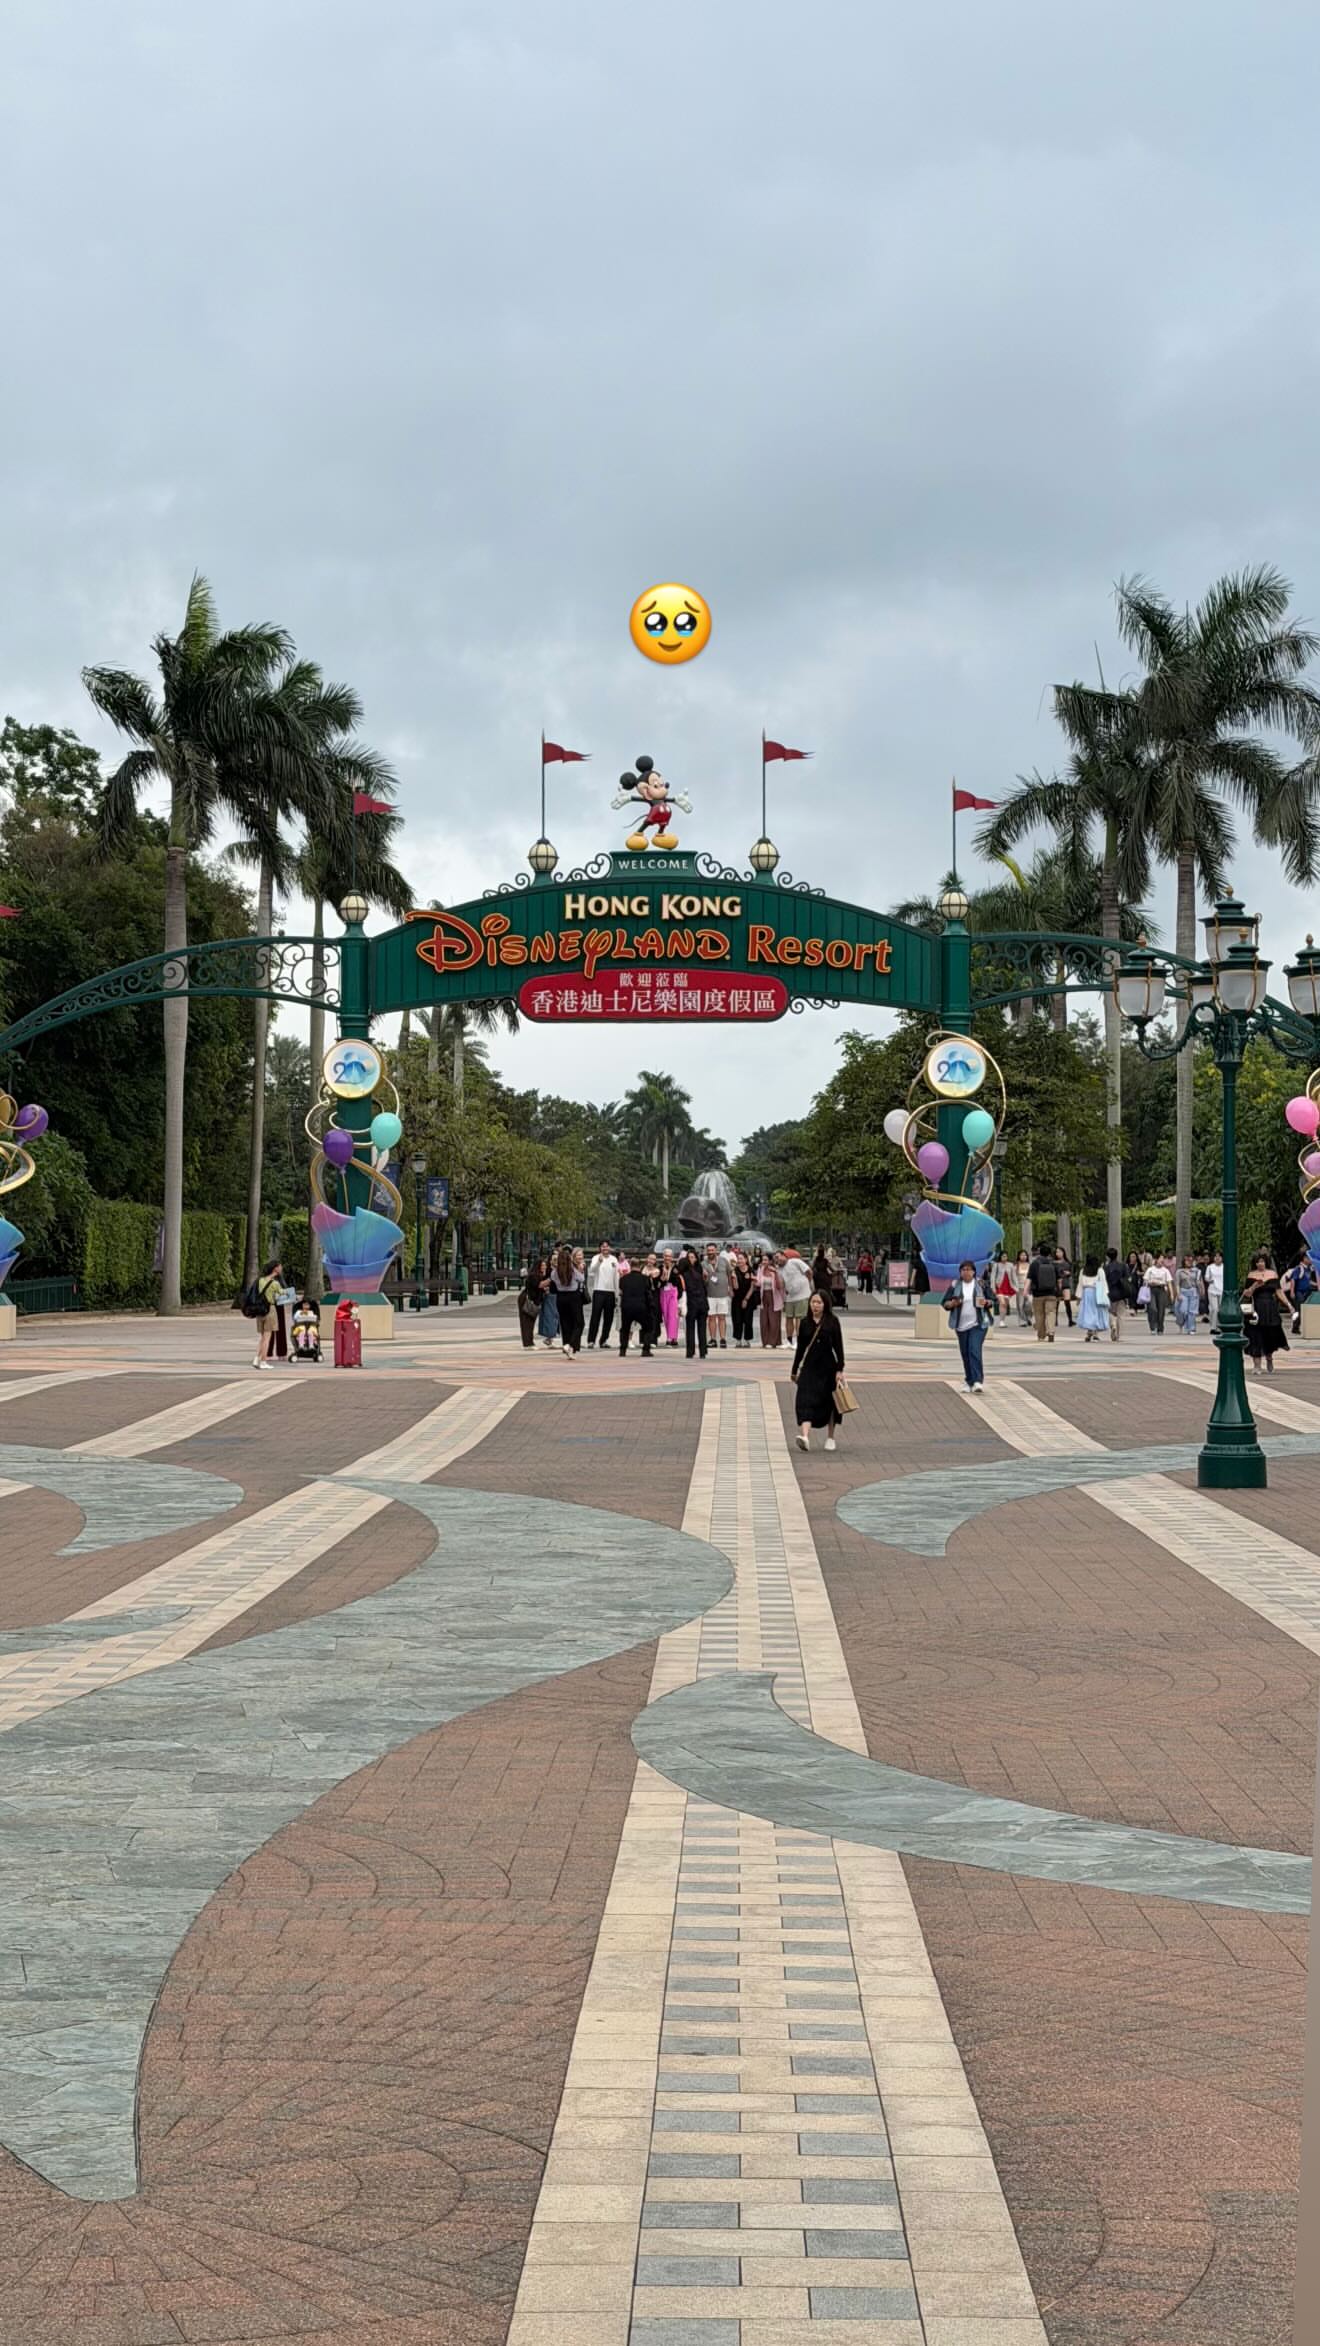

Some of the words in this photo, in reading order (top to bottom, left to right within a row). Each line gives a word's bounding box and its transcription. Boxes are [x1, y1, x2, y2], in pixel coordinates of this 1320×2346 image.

[618, 859, 689, 870] WELCOME
[564, 893, 650, 920] HONG
[661, 893, 742, 920] KONG
[747, 925, 893, 973] Resort
[531, 989, 776, 1014] 香港迪士尼樂園度假區
